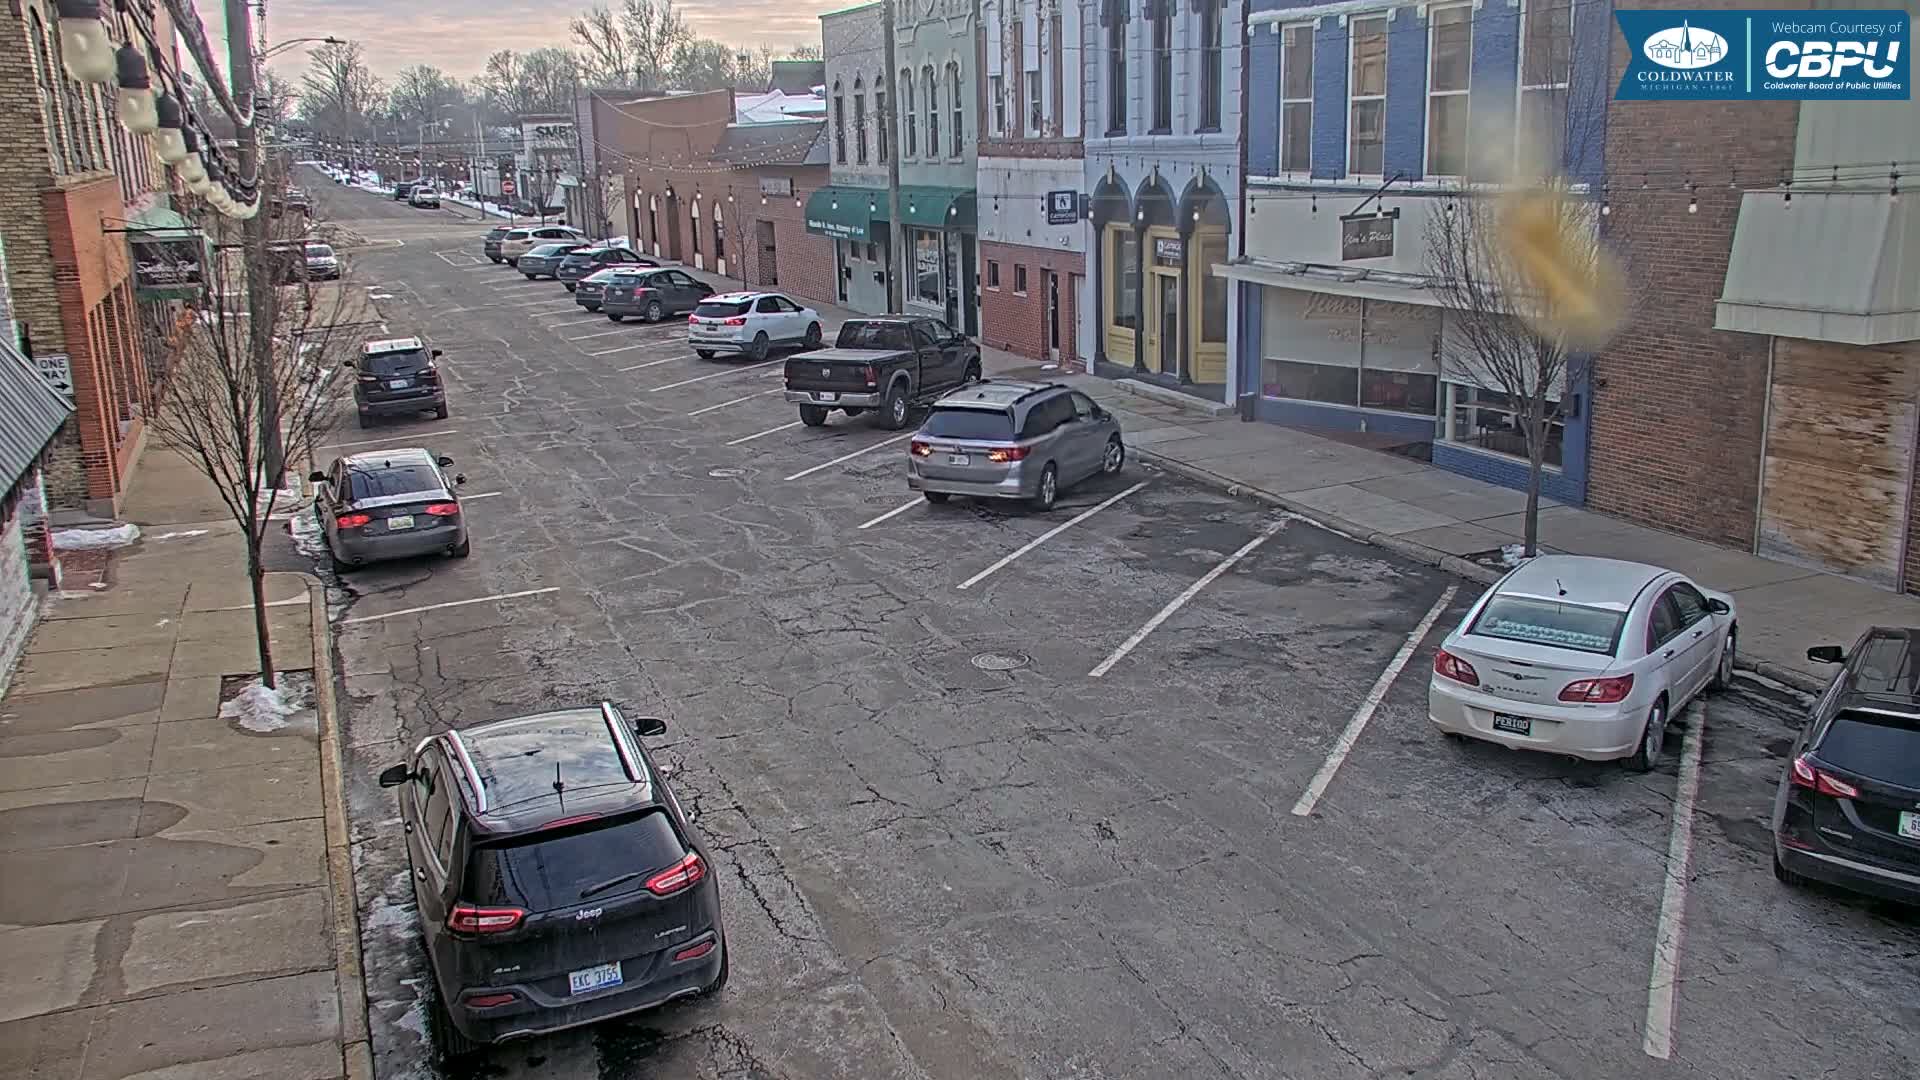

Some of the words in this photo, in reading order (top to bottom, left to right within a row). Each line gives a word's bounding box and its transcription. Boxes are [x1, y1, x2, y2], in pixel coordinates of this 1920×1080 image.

[40, 359, 65, 369] ONE
[1495, 715, 1530, 730] PERIOD
[576, 907, 603, 921] Jeep
